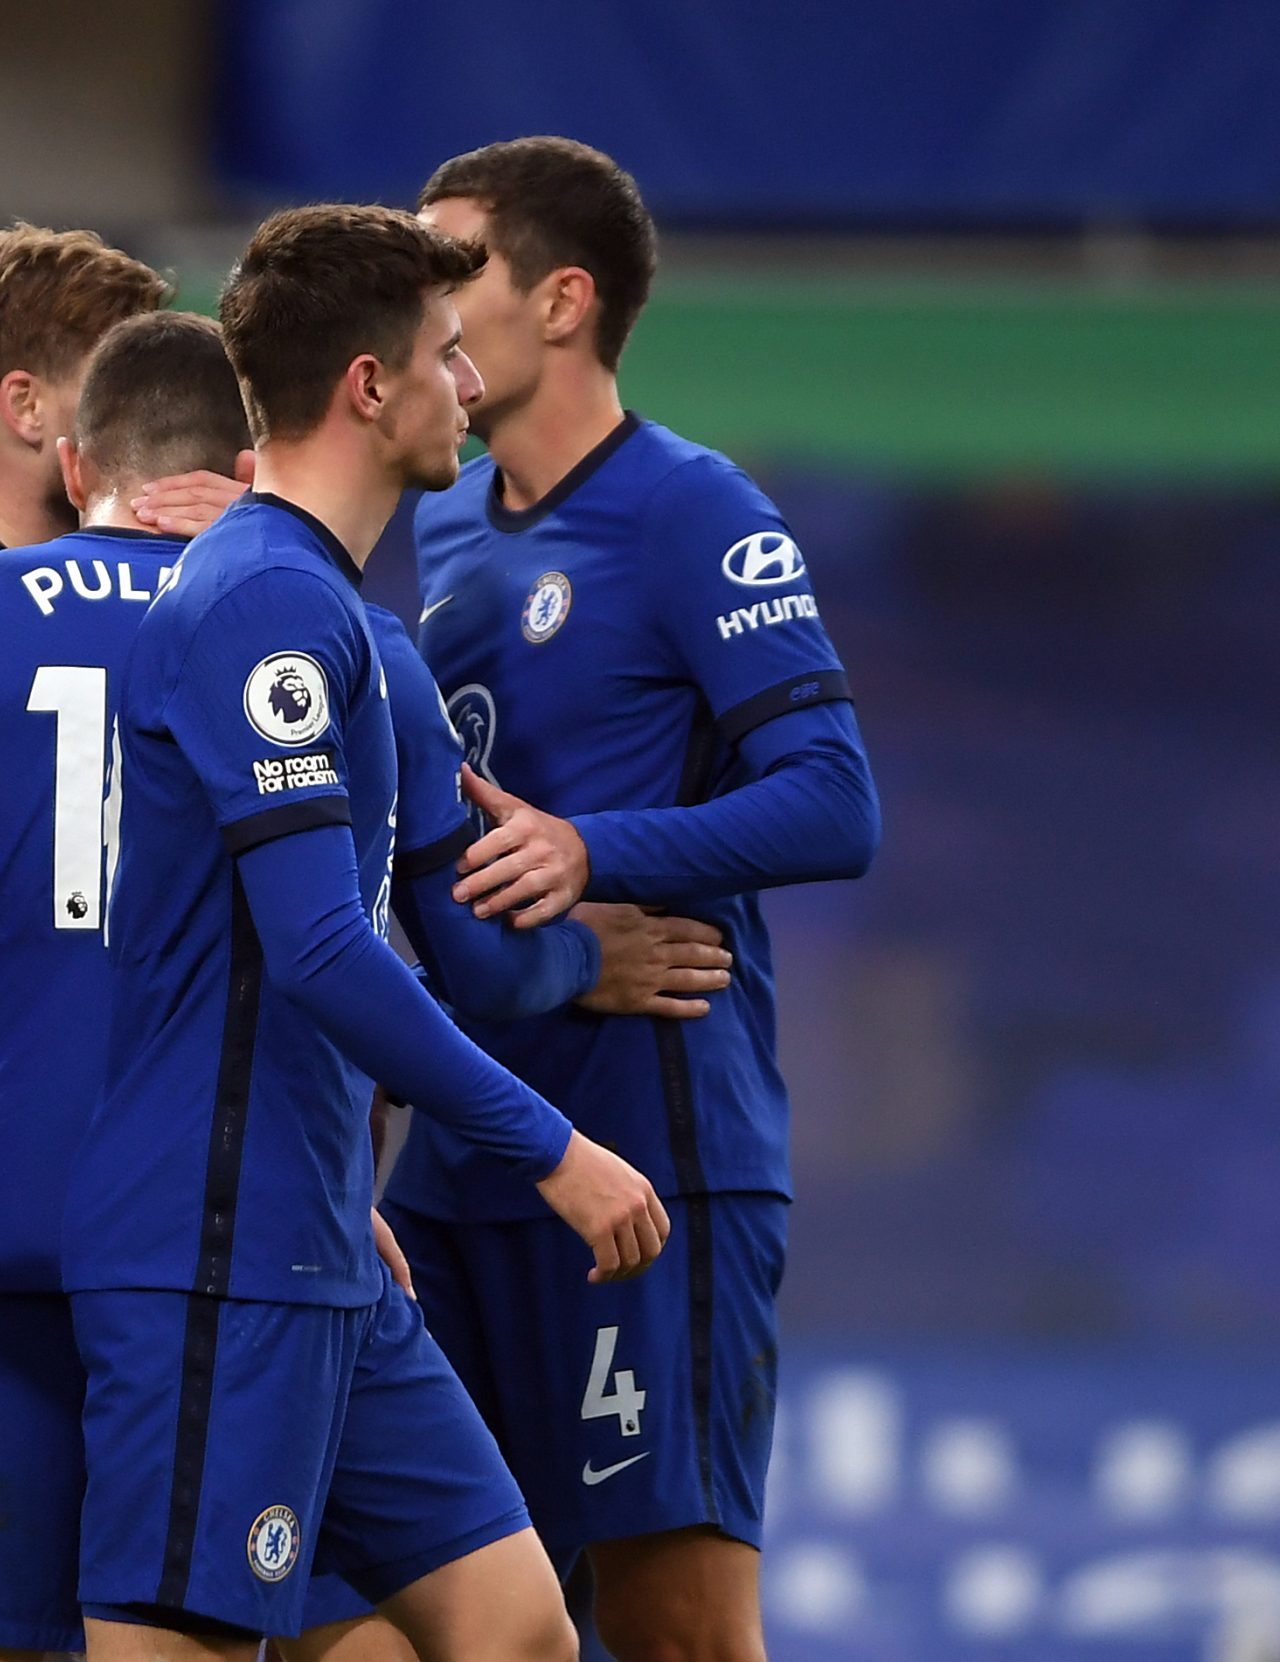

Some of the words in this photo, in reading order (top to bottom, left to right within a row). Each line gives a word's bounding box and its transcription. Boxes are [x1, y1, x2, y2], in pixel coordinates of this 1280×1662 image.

[253, 759, 283, 779] No
[285, 754, 329, 773] room
[257, 775, 285, 795] for
[286, 769, 339, 790] racism
[26, 666, 107, 930] 1
[581, 1326, 646, 1437] 4
[263, 1508, 295, 1528] CHELSEA
